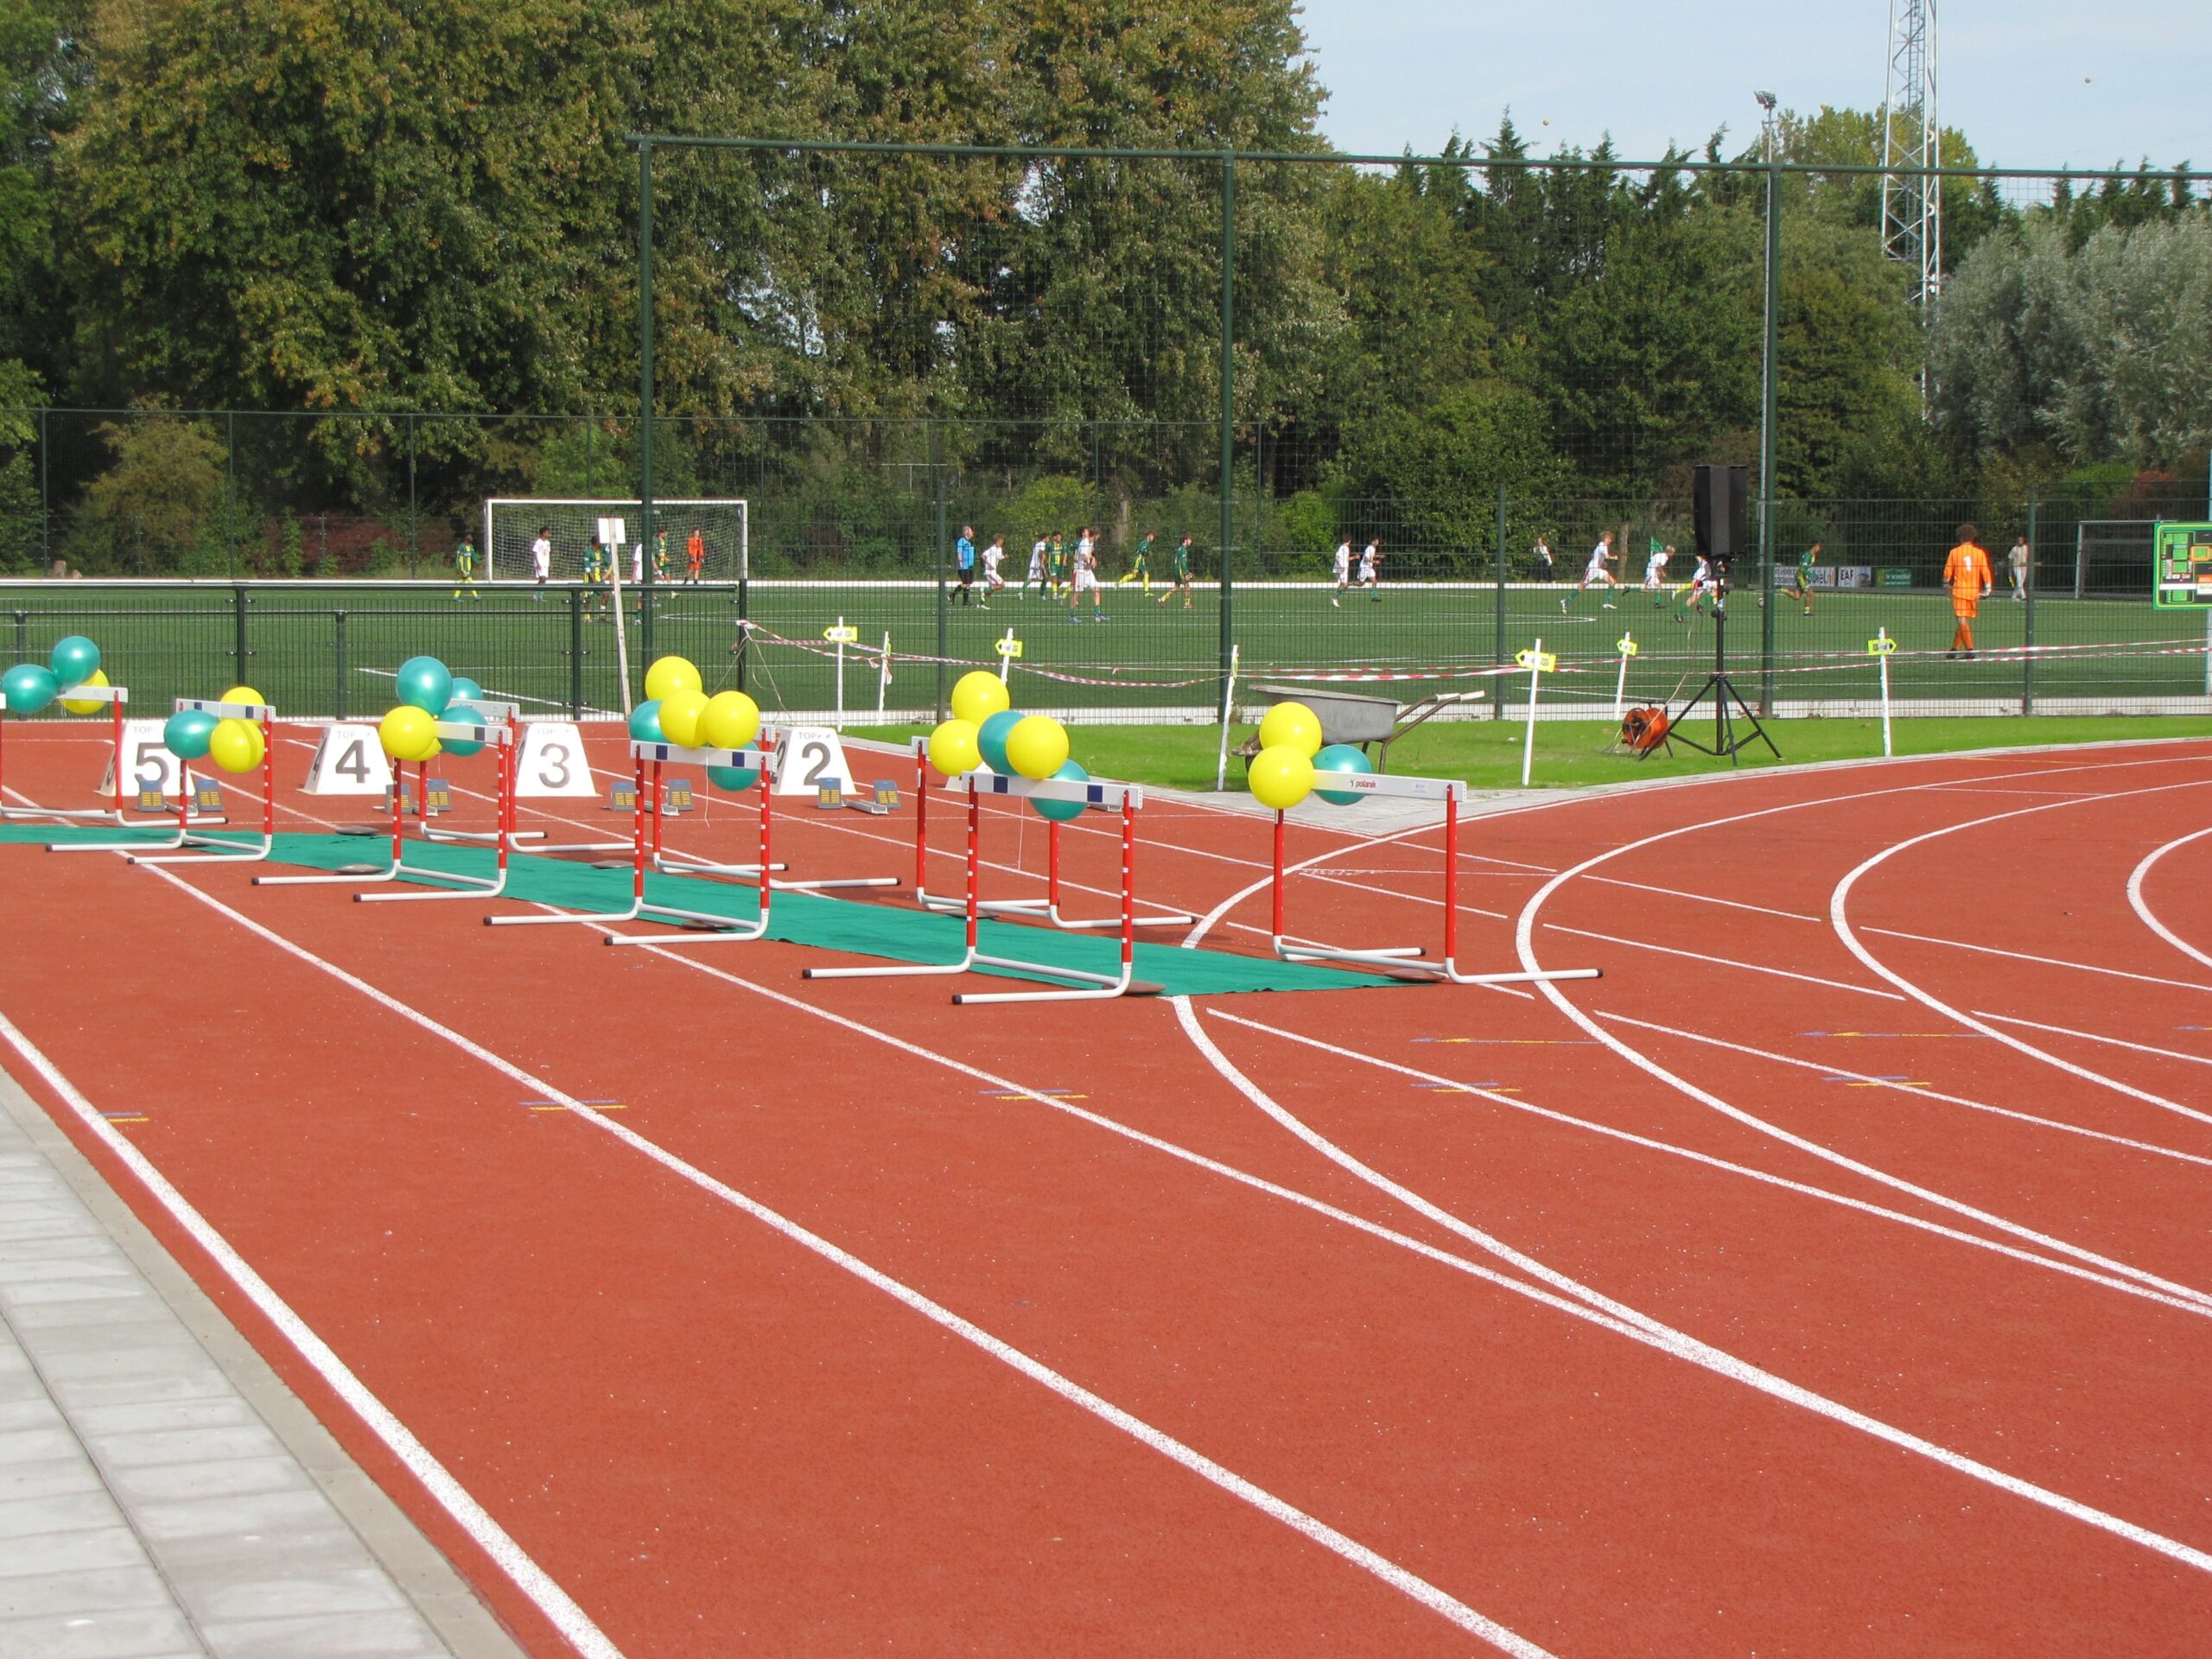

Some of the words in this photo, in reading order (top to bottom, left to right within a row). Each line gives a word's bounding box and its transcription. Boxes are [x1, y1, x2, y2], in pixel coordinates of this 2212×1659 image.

[1962, 556, 1972, 572] 1
[134, 742, 169, 785] 5
[335, 740, 371, 784] 4
[538, 743, 571, 789] 3
[802, 741, 831, 786] 2
[1355, 779, 1376, 788] polanik
